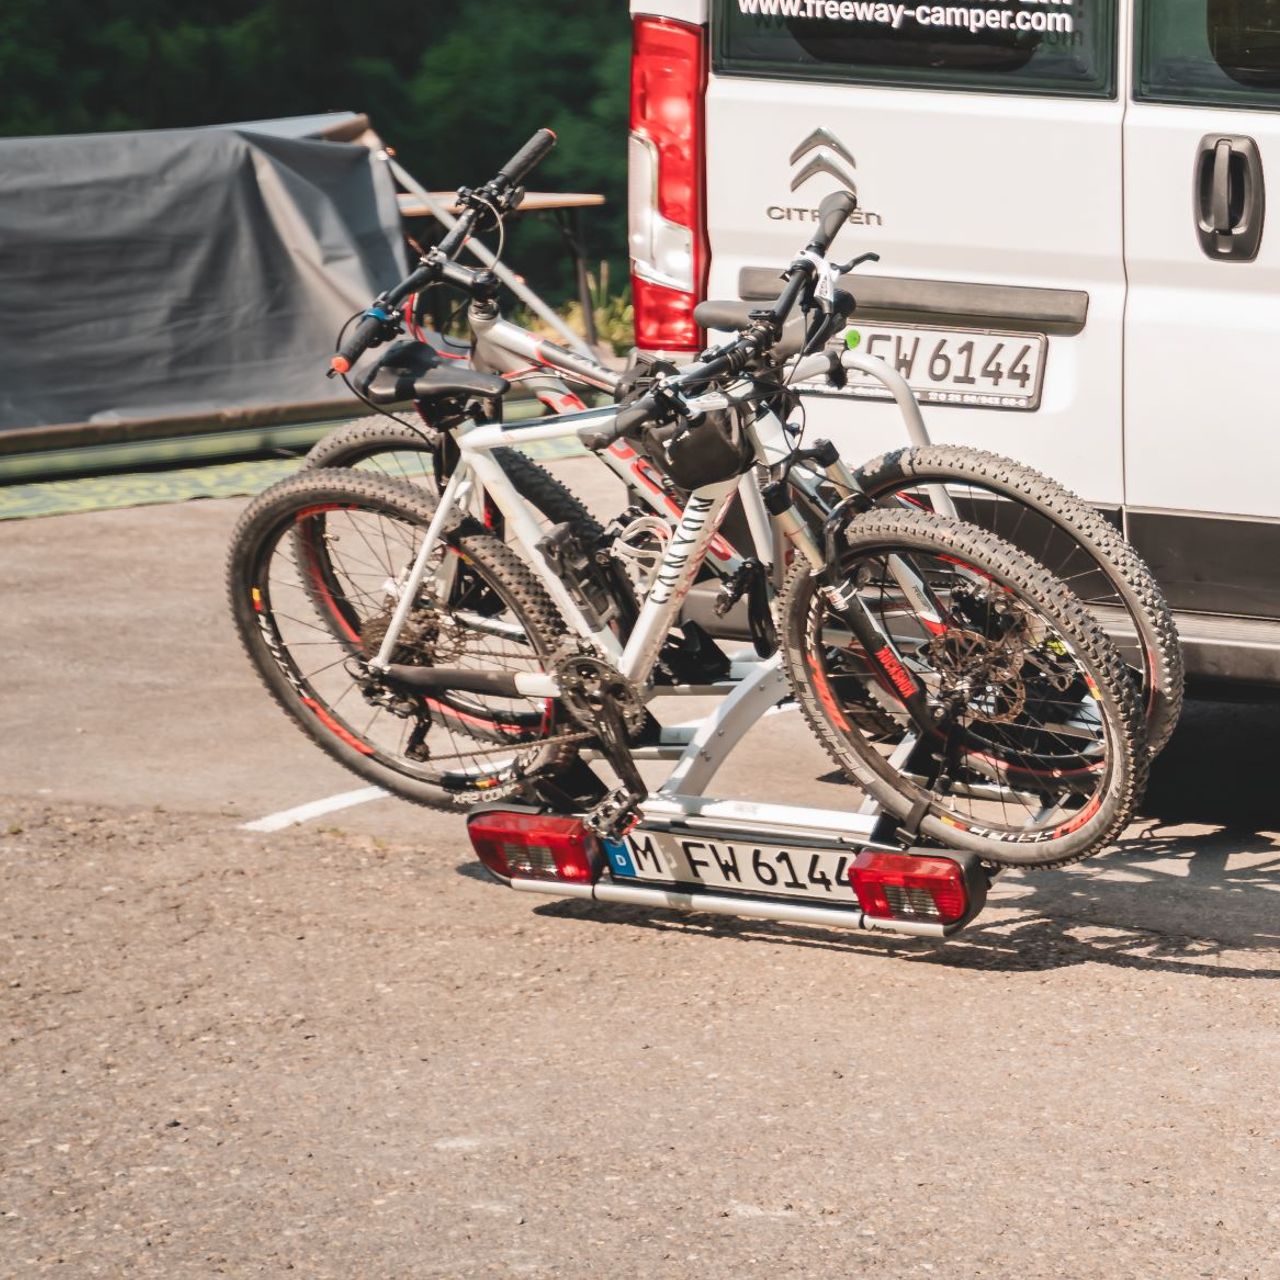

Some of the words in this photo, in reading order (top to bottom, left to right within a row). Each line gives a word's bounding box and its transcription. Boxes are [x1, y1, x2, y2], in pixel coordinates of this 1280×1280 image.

[766, 205, 883, 226] CITRËN
[865, 333, 921, 380] FW
[927, 338, 1032, 389] 6144
[649, 495, 716, 605] CANYON
[874, 645, 918, 699] ROCKSHOX
[616, 853, 627, 867] D
[627, 834, 662, 874] M
[681, 840, 742, 883] FW
